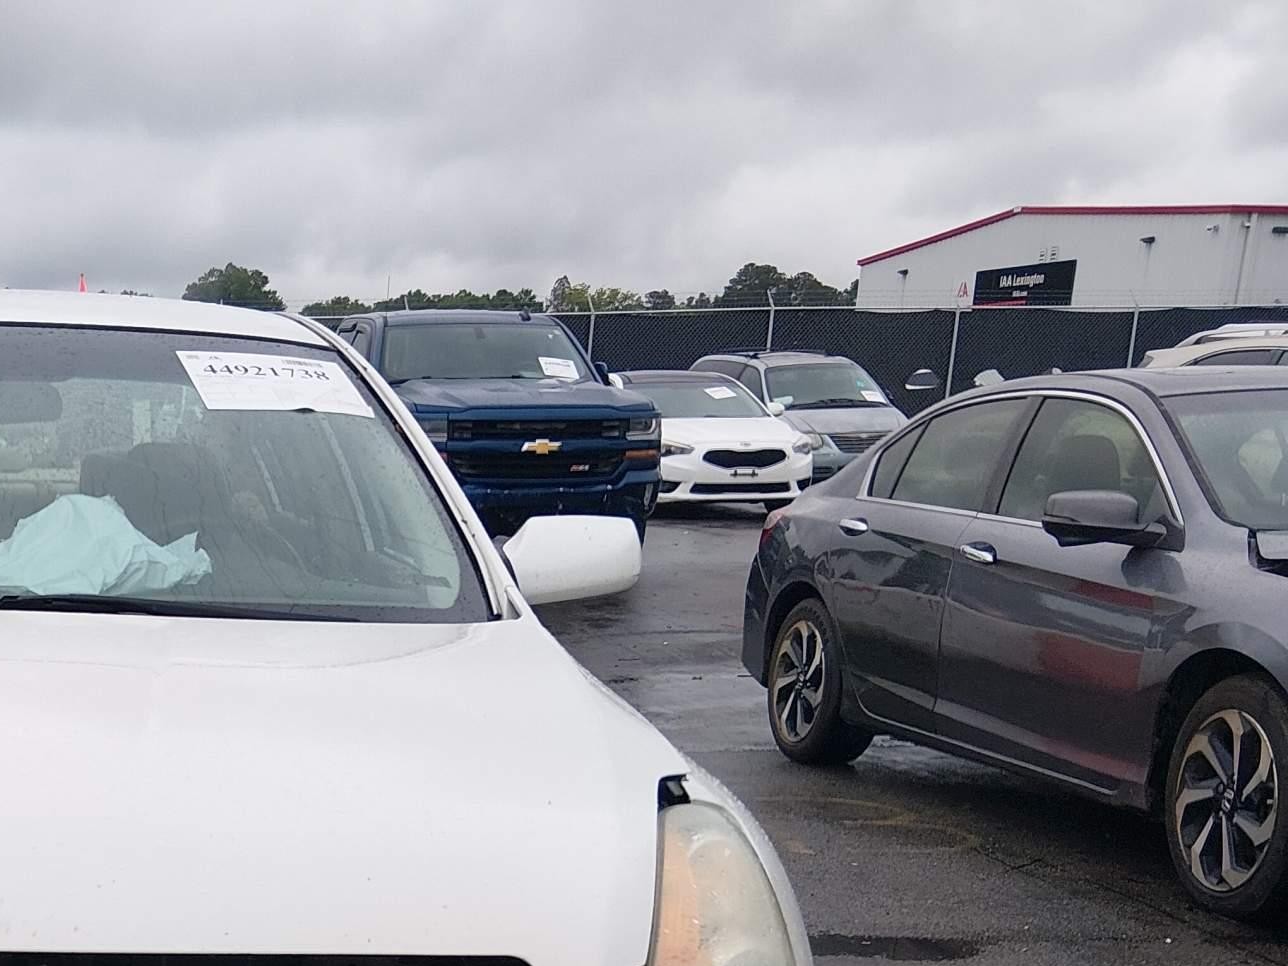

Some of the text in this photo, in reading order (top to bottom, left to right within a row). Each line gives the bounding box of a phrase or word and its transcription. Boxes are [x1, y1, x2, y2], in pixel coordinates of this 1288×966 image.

[999, 273, 1045, 288] IAA Lexington
[203, 364, 330, 381] 44921738
